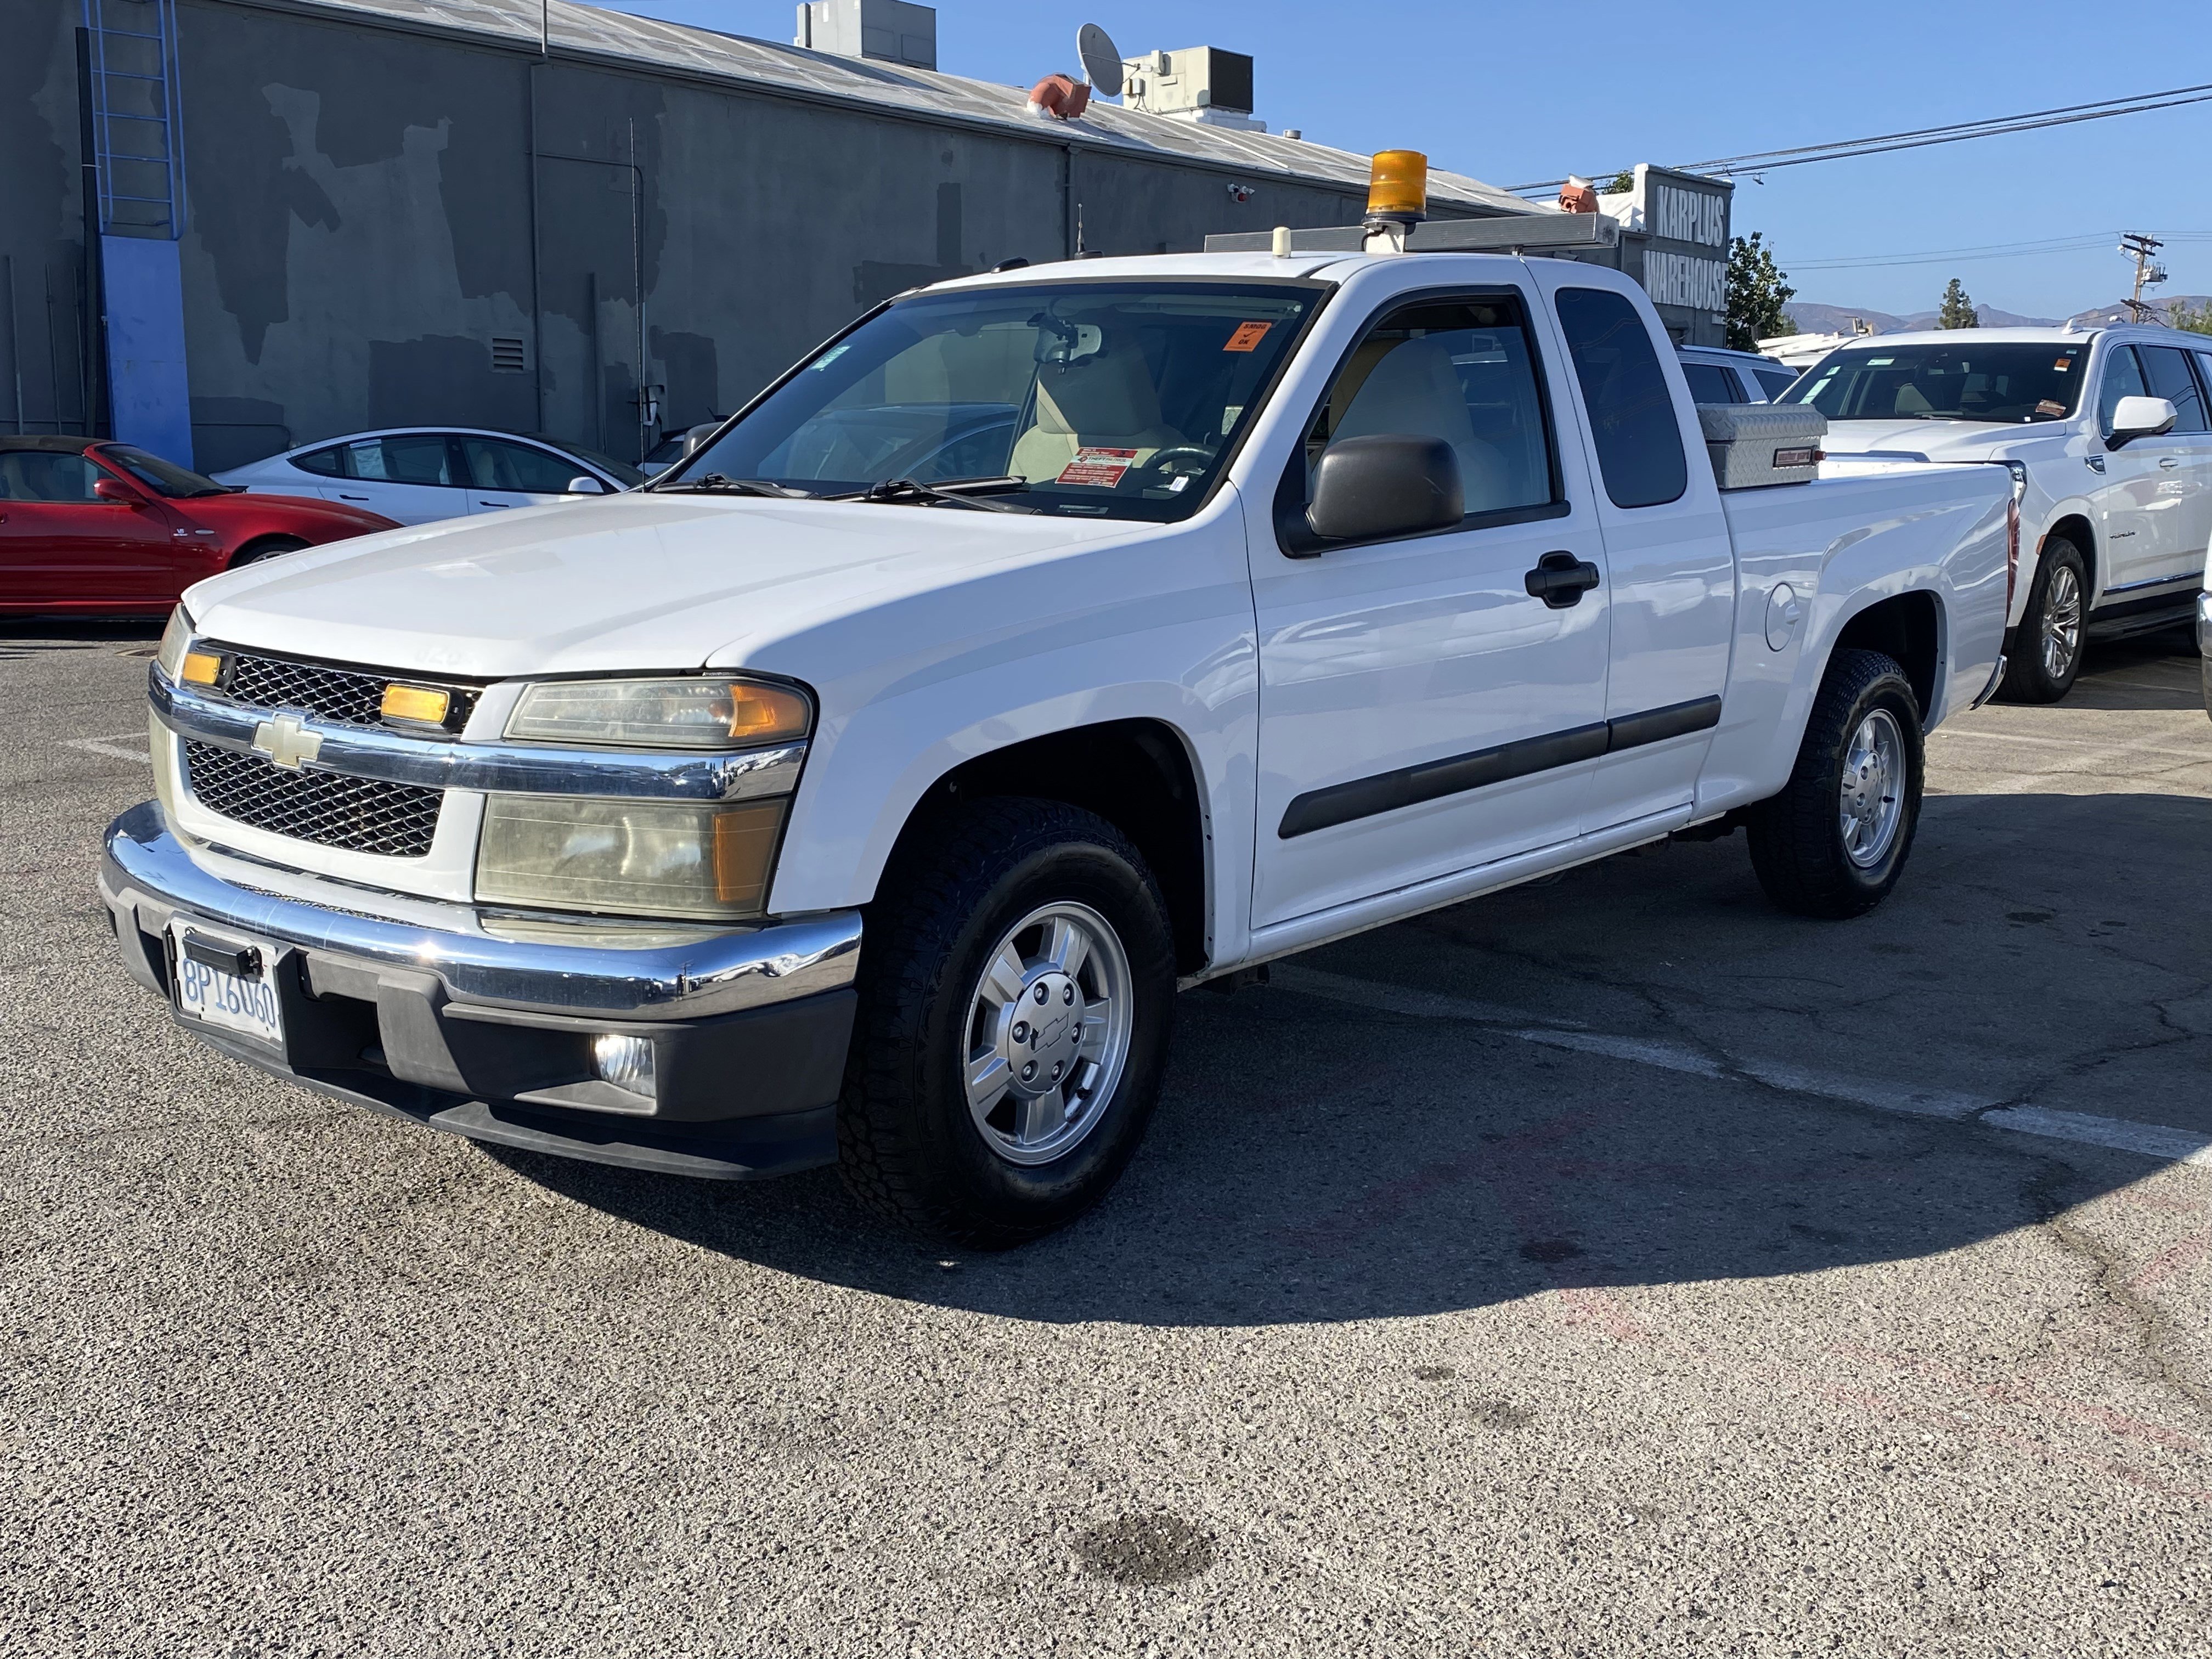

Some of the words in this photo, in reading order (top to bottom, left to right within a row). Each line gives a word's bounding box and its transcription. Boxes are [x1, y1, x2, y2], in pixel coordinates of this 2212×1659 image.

[1656, 185, 1724, 247] KARPLUS
[1643, 250, 1729, 311] WAREHOUSE
[183, 958, 275, 1028] 8P16060
